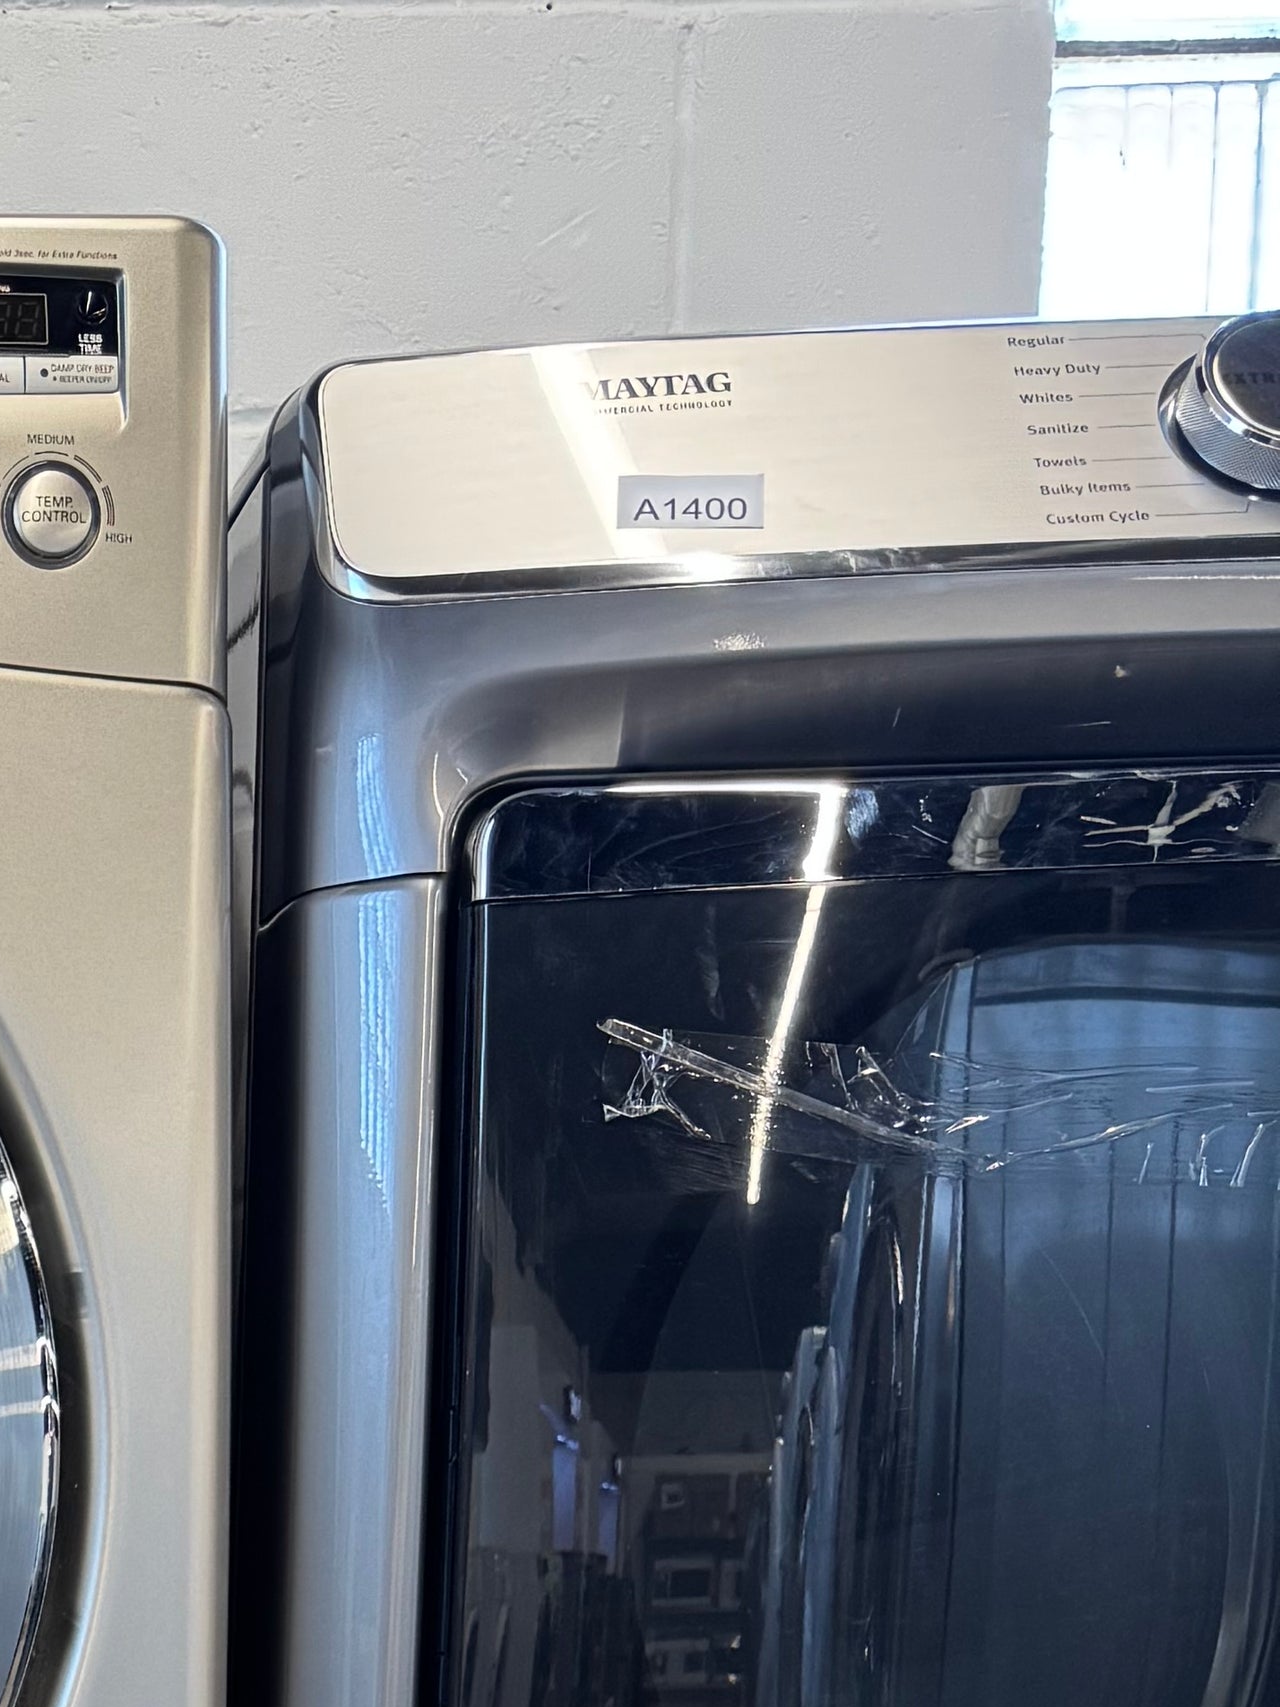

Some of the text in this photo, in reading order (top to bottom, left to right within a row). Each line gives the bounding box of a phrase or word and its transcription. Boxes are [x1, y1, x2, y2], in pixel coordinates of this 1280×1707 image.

[1008, 336, 1064, 348] Regular
[1014, 364, 1100, 376] Heavy Duty
[586, 372, 732, 400] MAYTAG
[1020, 392, 1073, 404] Whites
[1028, 424, 1088, 435] Sanitize
[27, 434, 75, 446] MEDIUM
[1035, 456, 1086, 468] Towels
[1040, 482, 1130, 496] Bulky Items
[36, 496, 73, 508] TEMP.
[634, 498, 747, 521] A1400
[22, 510, 86, 524] CONTROL
[1046, 510, 1149, 525] Custom Cycle
[106, 533, 132, 544] HIGH
